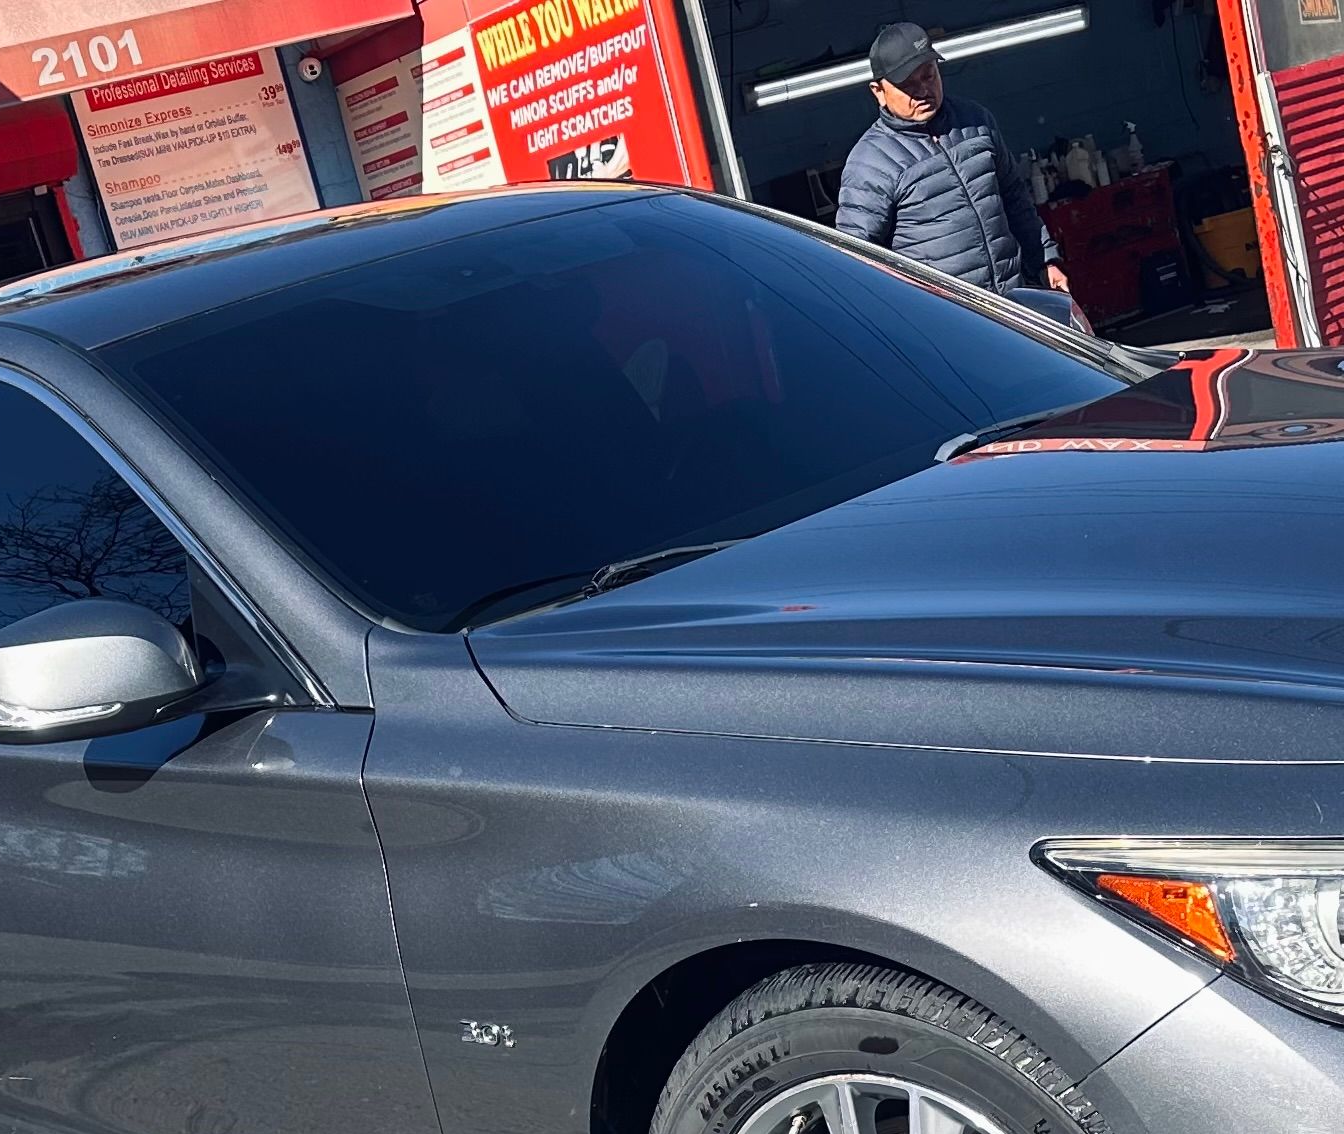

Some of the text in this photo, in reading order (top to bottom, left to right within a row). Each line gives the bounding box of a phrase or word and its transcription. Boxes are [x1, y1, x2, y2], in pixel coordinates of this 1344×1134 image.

[476, 10, 537, 71] WHILE
[531, 0, 575, 48] YOU
[31, 28, 143, 86] 2101
[487, 83, 509, 108] WE
[510, 72, 534, 99] CAN
[536, 24, 647, 90] REMOVE/BUFFOUT
[91, 56, 255, 104] Professional Detailing Services
[510, 100, 548, 129] MINOR
[550, 79, 594, 115] SCUFFS
[597, 64, 638, 96] and/or
[87, 106, 192, 136] Simonize Express
[169, 127, 179, 139] by
[178, 123, 196, 135] hand
[196, 123, 204, 131] or
[230, 124, 257, 139] EXTRA)
[527, 123, 558, 153] LIGHT
[561, 96, 634, 141] SCRATCHES
[104, 172, 161, 195] Shampoo
[110, 196, 143, 211] Shampoo
[198, 206, 234, 222] SLIGHTLY
